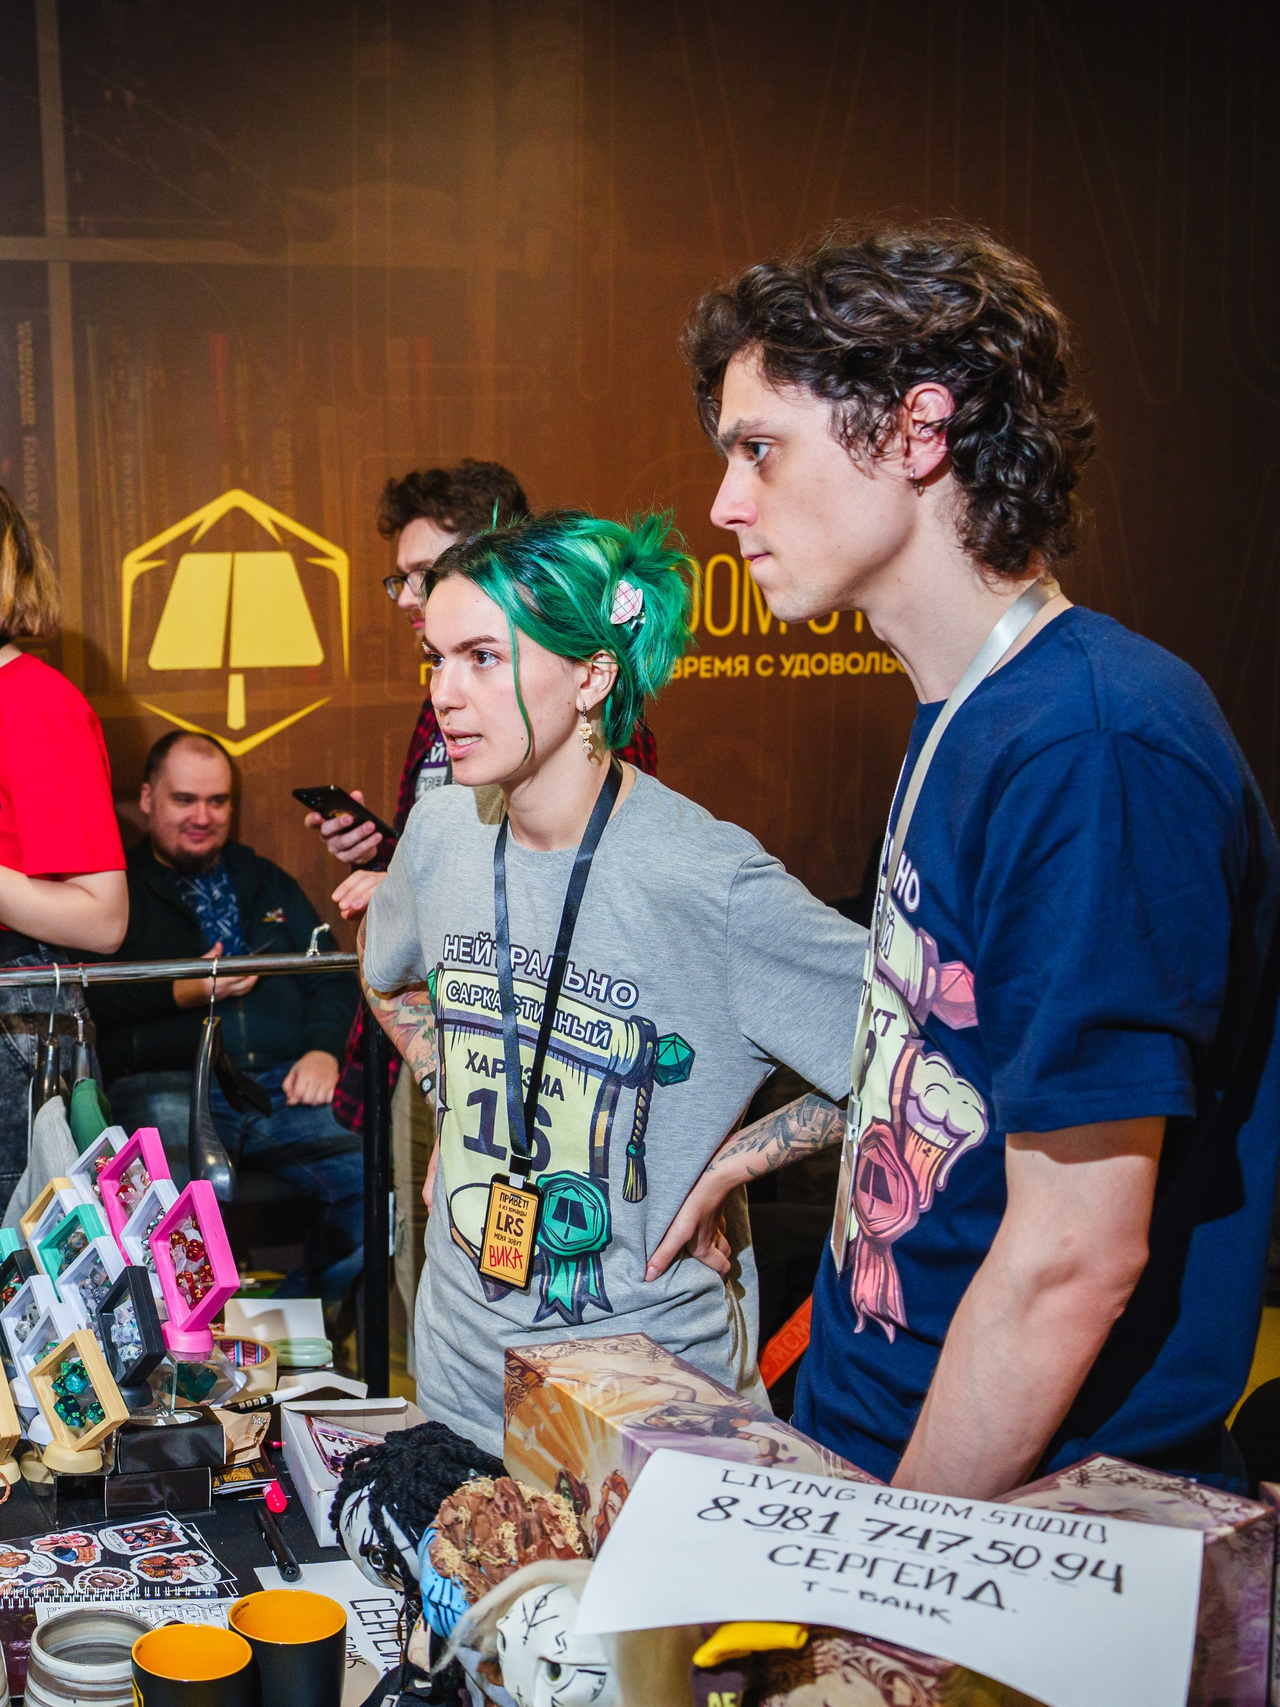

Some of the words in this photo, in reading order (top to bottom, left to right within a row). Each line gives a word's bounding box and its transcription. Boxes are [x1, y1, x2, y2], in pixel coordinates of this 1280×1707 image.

[685, 553, 787, 637] OOM
[671, 654, 750, 680] ВРЕМЯ
[755, 654, 775, 676] С
[442, 931, 640, 1010] НЕЙРАЬНО
[446, 979, 613, 1051] САРКАСТИНЫЙ
[464, 1047, 566, 1102] ХАРЗМА
[463, 1087, 553, 1173] 16
[496, 1211, 525, 1238] LRS
[499, 1192, 530, 1211] ПРИВЕТ!
[489, 1244, 524, 1270] ВИКА
[493, 1231, 507, 1243] МЕНЯ
[506, 1236, 523, 1248] ЗОВУТ
[720, 1469, 857, 1501] LIVING
[874, 1492, 974, 1520] ROOM
[981, 1509, 1108, 1544] STUDIO
[696, 1496, 741, 1522] 8
[743, 1503, 841, 1536] 981
[860, 1517, 974, 1554] 747
[972, 1539, 1042, 1570] 50
[1050, 1552, 1124, 1595] 94
